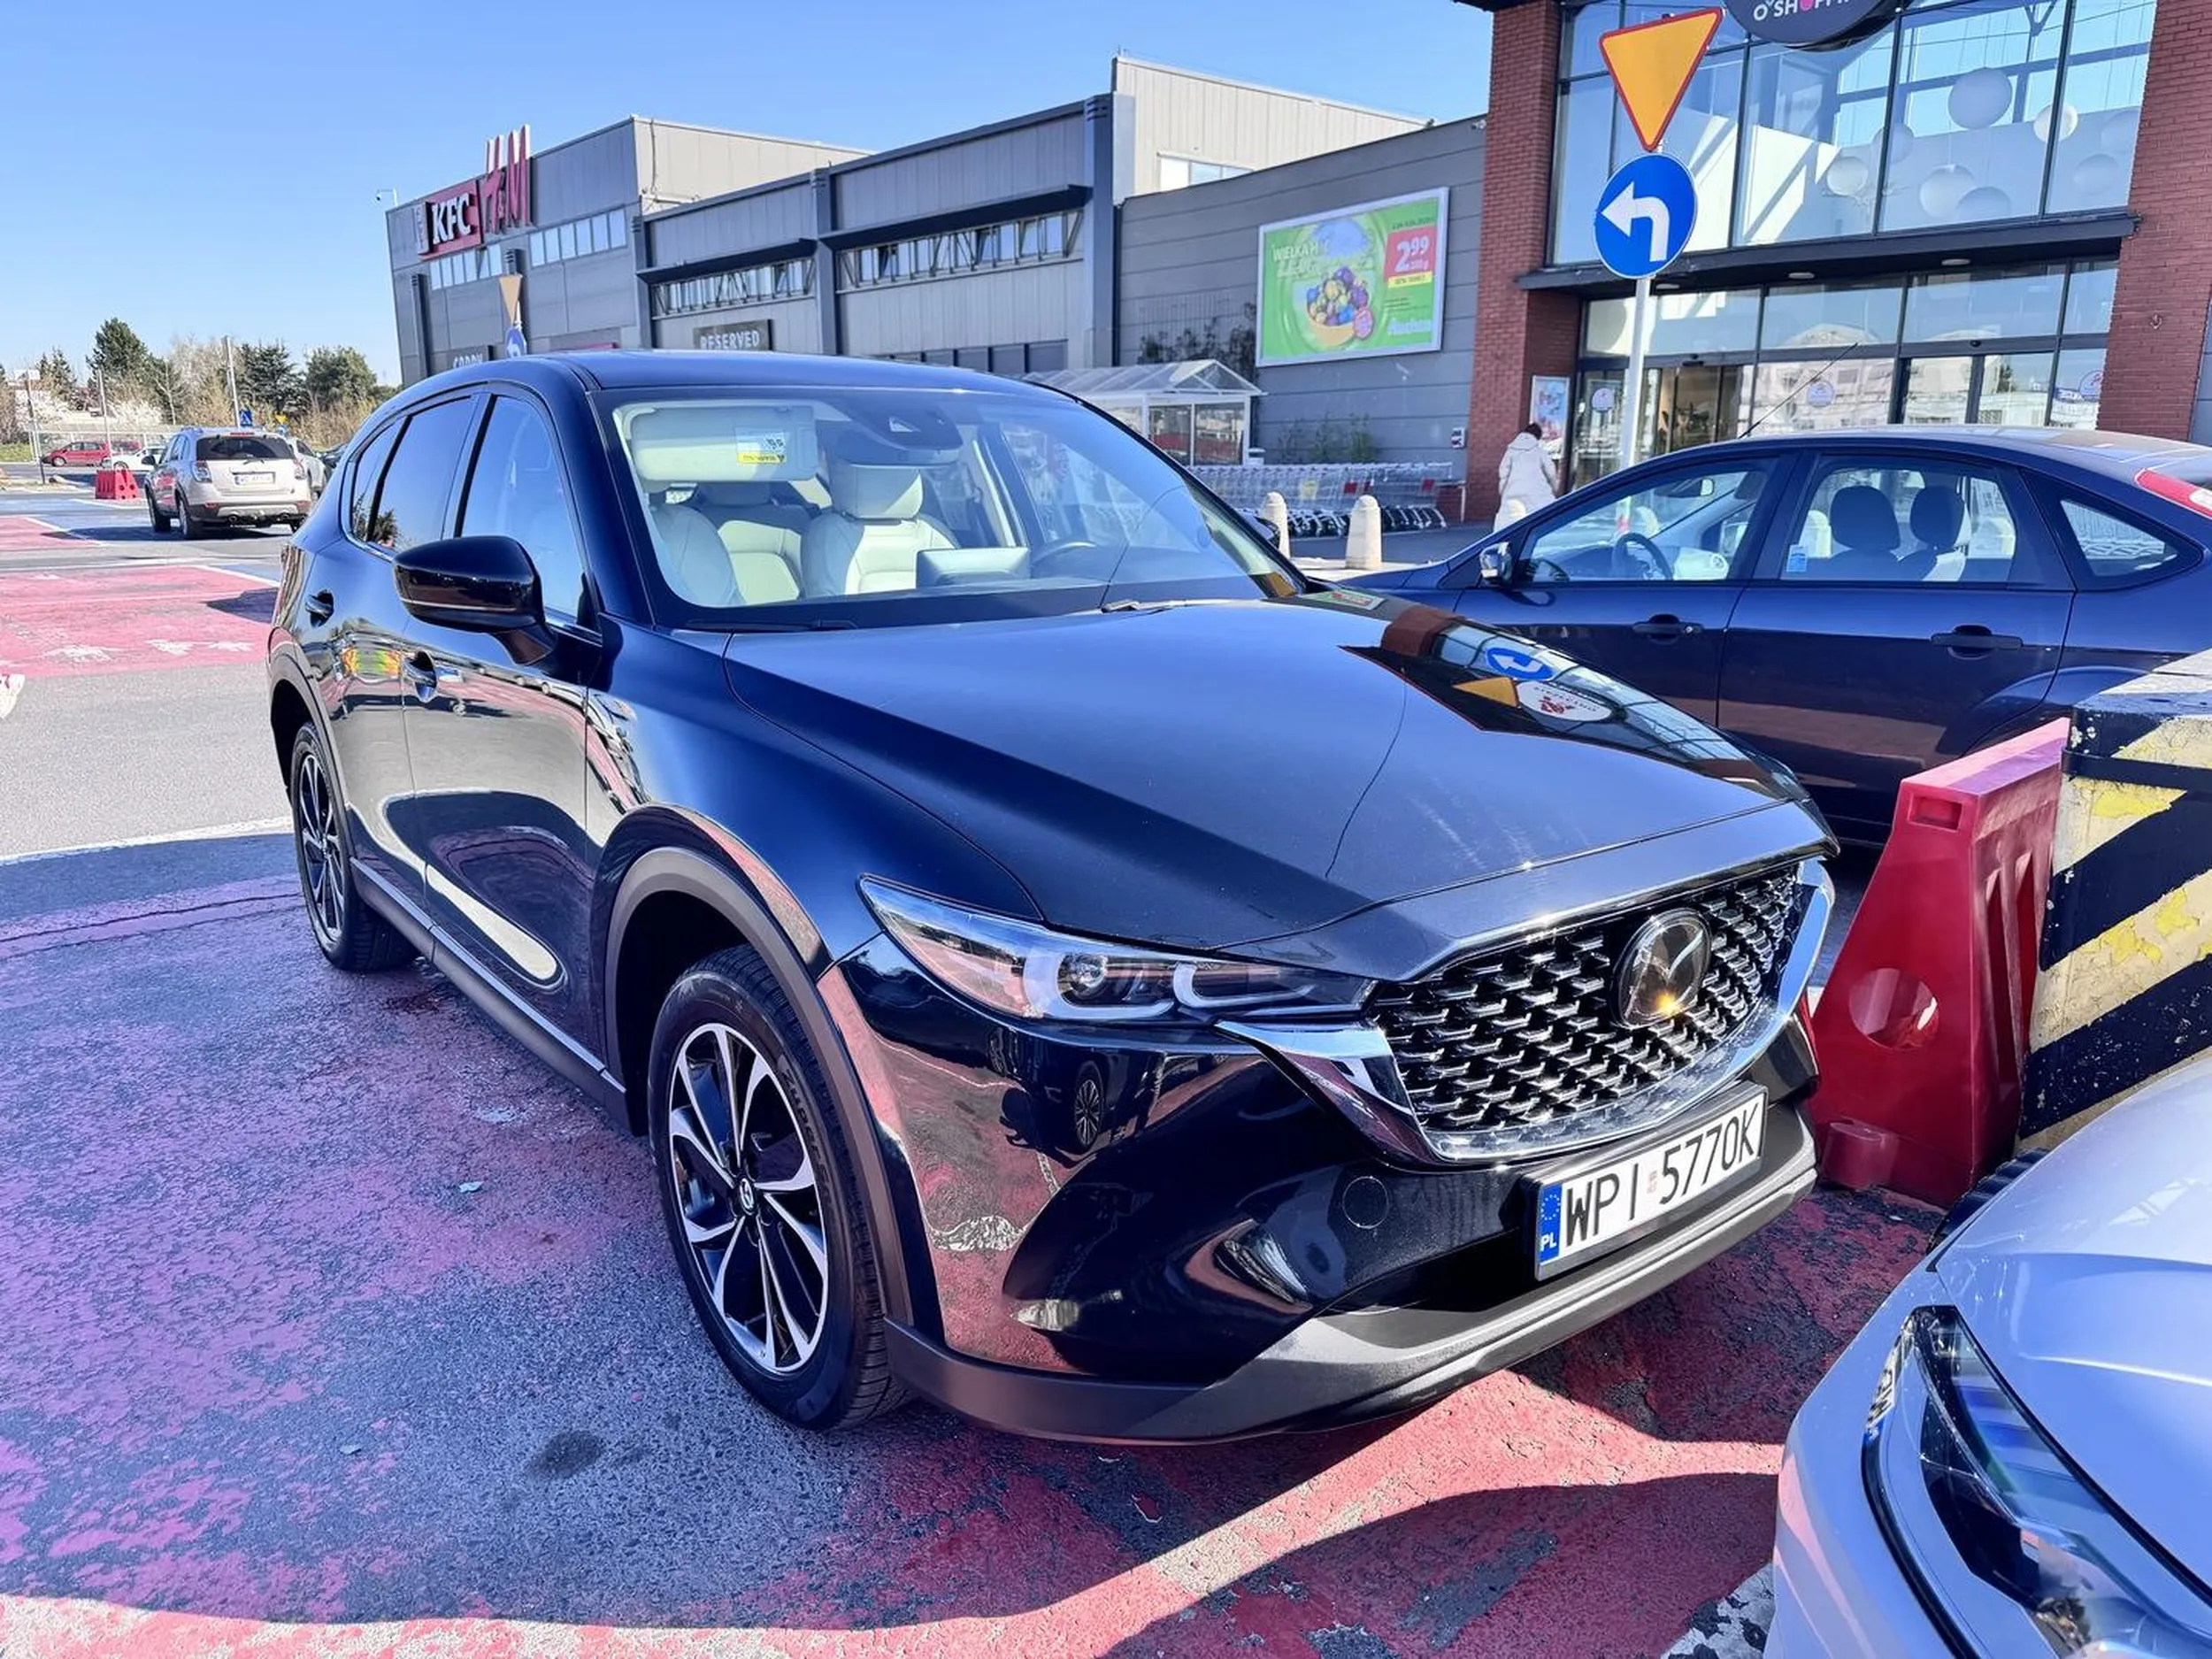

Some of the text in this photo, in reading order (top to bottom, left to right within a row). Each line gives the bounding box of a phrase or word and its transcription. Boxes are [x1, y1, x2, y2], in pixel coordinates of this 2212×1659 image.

[432, 192, 472, 245] KFC
[700, 329, 759, 350] RESERVED
[1566, 1103, 1759, 1247] WPI 5770K
[1540, 1233, 1557, 1253] PL
